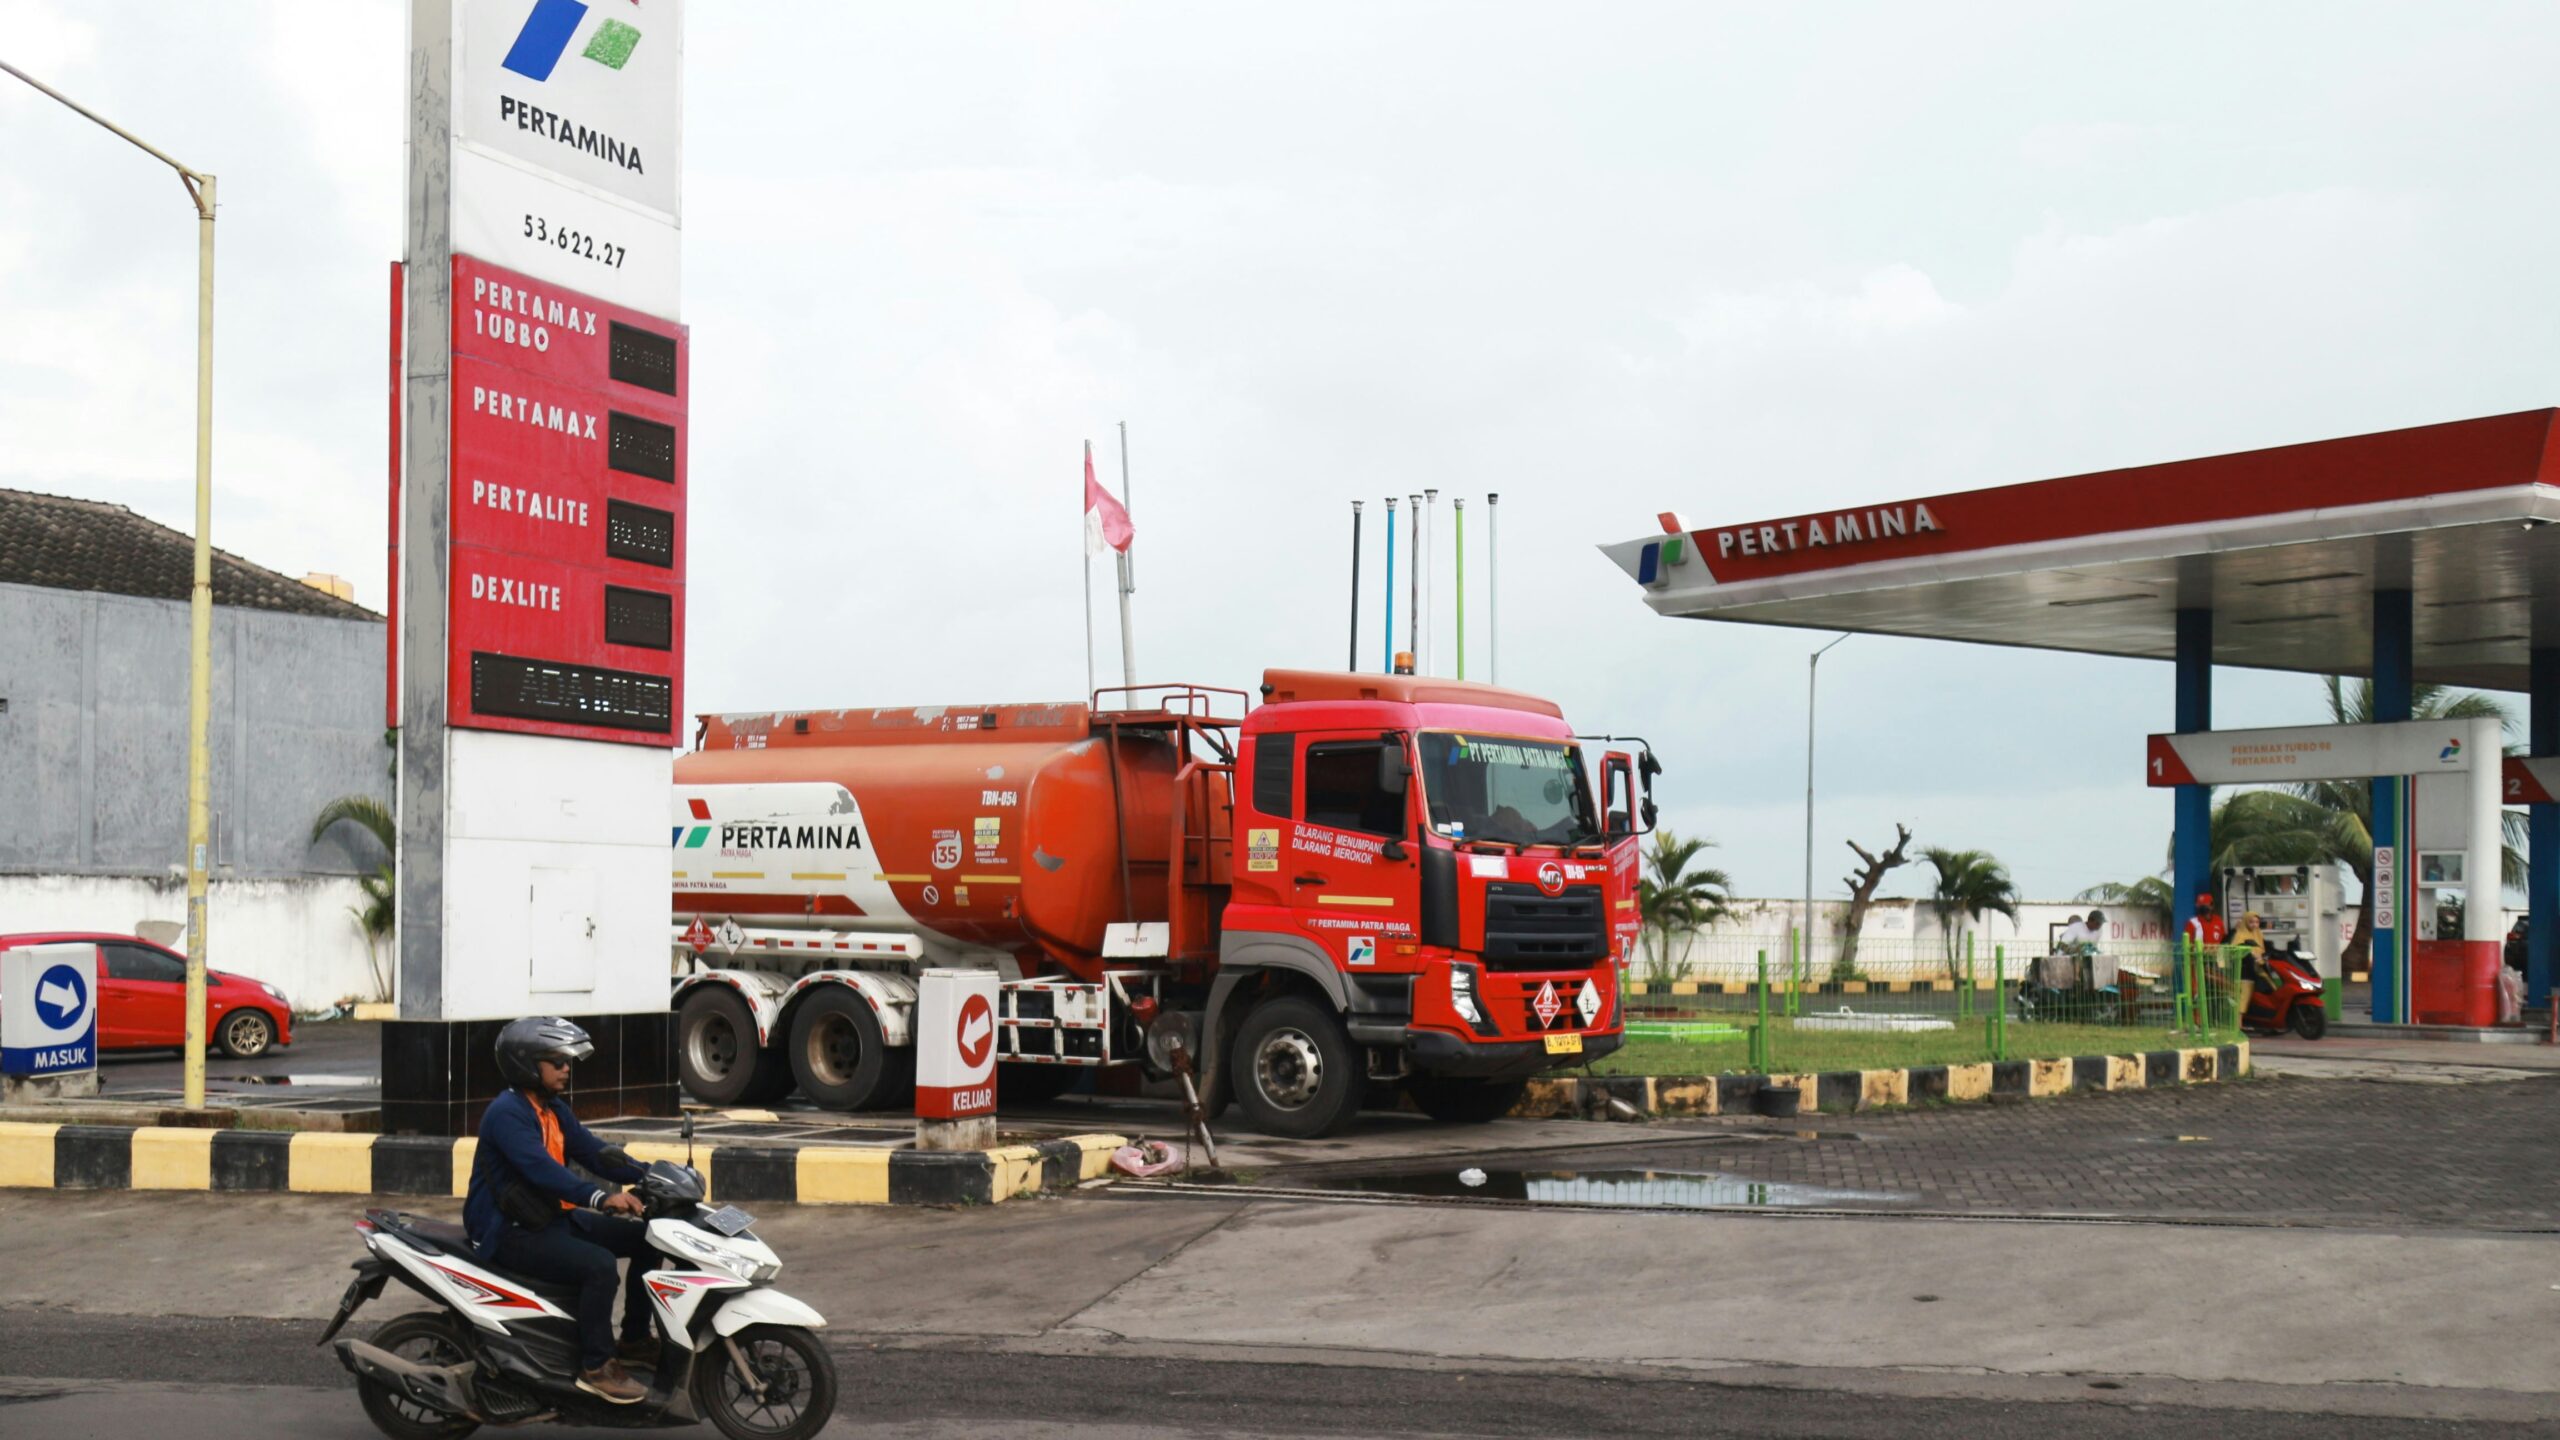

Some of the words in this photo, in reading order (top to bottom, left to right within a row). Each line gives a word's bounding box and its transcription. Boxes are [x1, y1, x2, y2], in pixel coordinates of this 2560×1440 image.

[500, 95, 644, 175] PERTAMINA
[523, 214, 626, 269] 53.622.27
[474, 277, 597, 336] PERTAMAX
[474, 386, 597, 440] PERTAMAX
[473, 480, 588, 527] PERTALITE
[1718, 503, 1937, 559] PERTAMINA
[472, 573, 561, 611] DEXLITE
[1480, 743, 1524, 766] PERTAMINA
[2232, 744, 2283, 754] PERTAMAX
[2285, 742, 2316, 753] TURBO
[2152, 757, 2163, 777] 1
[2232, 757, 2281, 766] PERTAMAX
[2508, 778, 2521, 795] 2
[982, 790, 1018, 806] TBN-054
[721, 826, 862, 849] PERTAMINA
[1295, 824, 1334, 843] DILARANG
[934, 846, 958, 864] 135
[1292, 837, 1331, 856] DILARANG
[1333, 847, 1373, 864] MEROKOK
[690, 881, 708, 889] PATRA
[1318, 919, 1360, 929] PERTAMINA
[1360, 920, 1385, 931] PATRA
[1386, 922, 1411, 931] NIAGA
[34, 1047, 87, 1069] MASUK
[953, 1088, 992, 1111] KELUAR
[657, 1277, 687, 1288] HONDA
